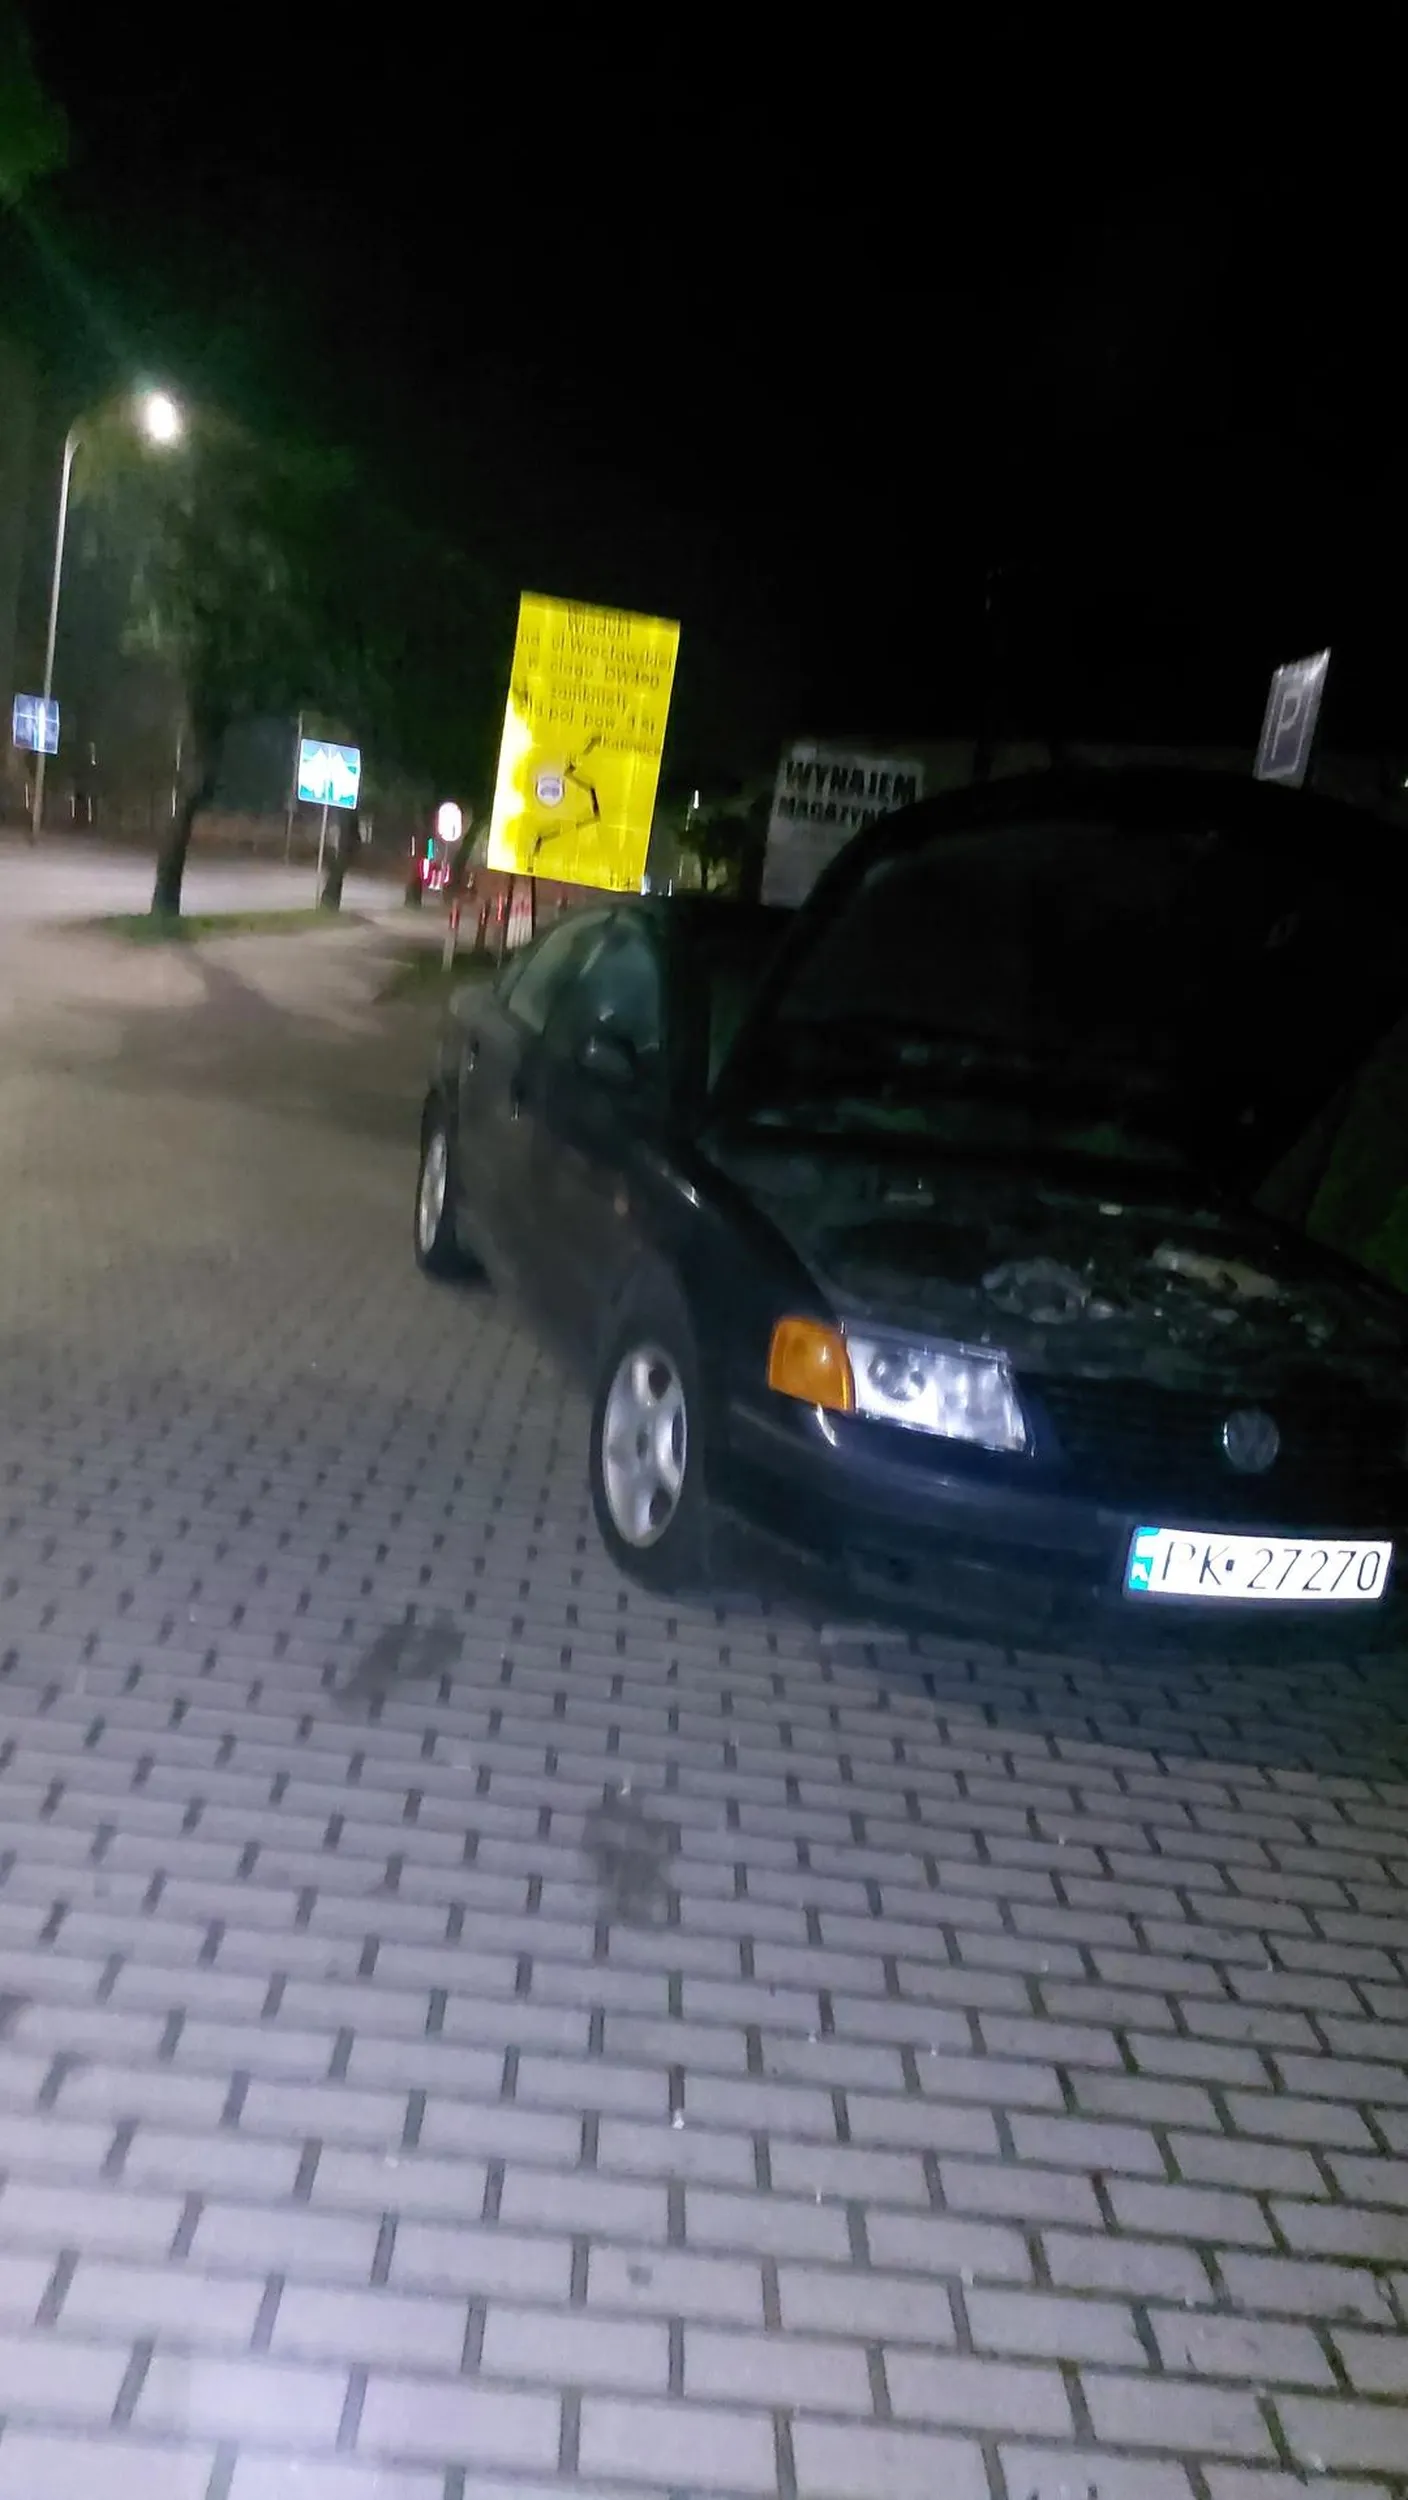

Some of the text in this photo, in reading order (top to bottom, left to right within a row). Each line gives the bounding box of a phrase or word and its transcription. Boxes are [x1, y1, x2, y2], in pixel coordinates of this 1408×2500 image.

[1270, 688, 1303, 763] P
[785, 761, 917, 808] WYNAJEM
[777, 796, 886, 829] MAGAZYN
[1247, 1549, 1380, 1592] 27270
